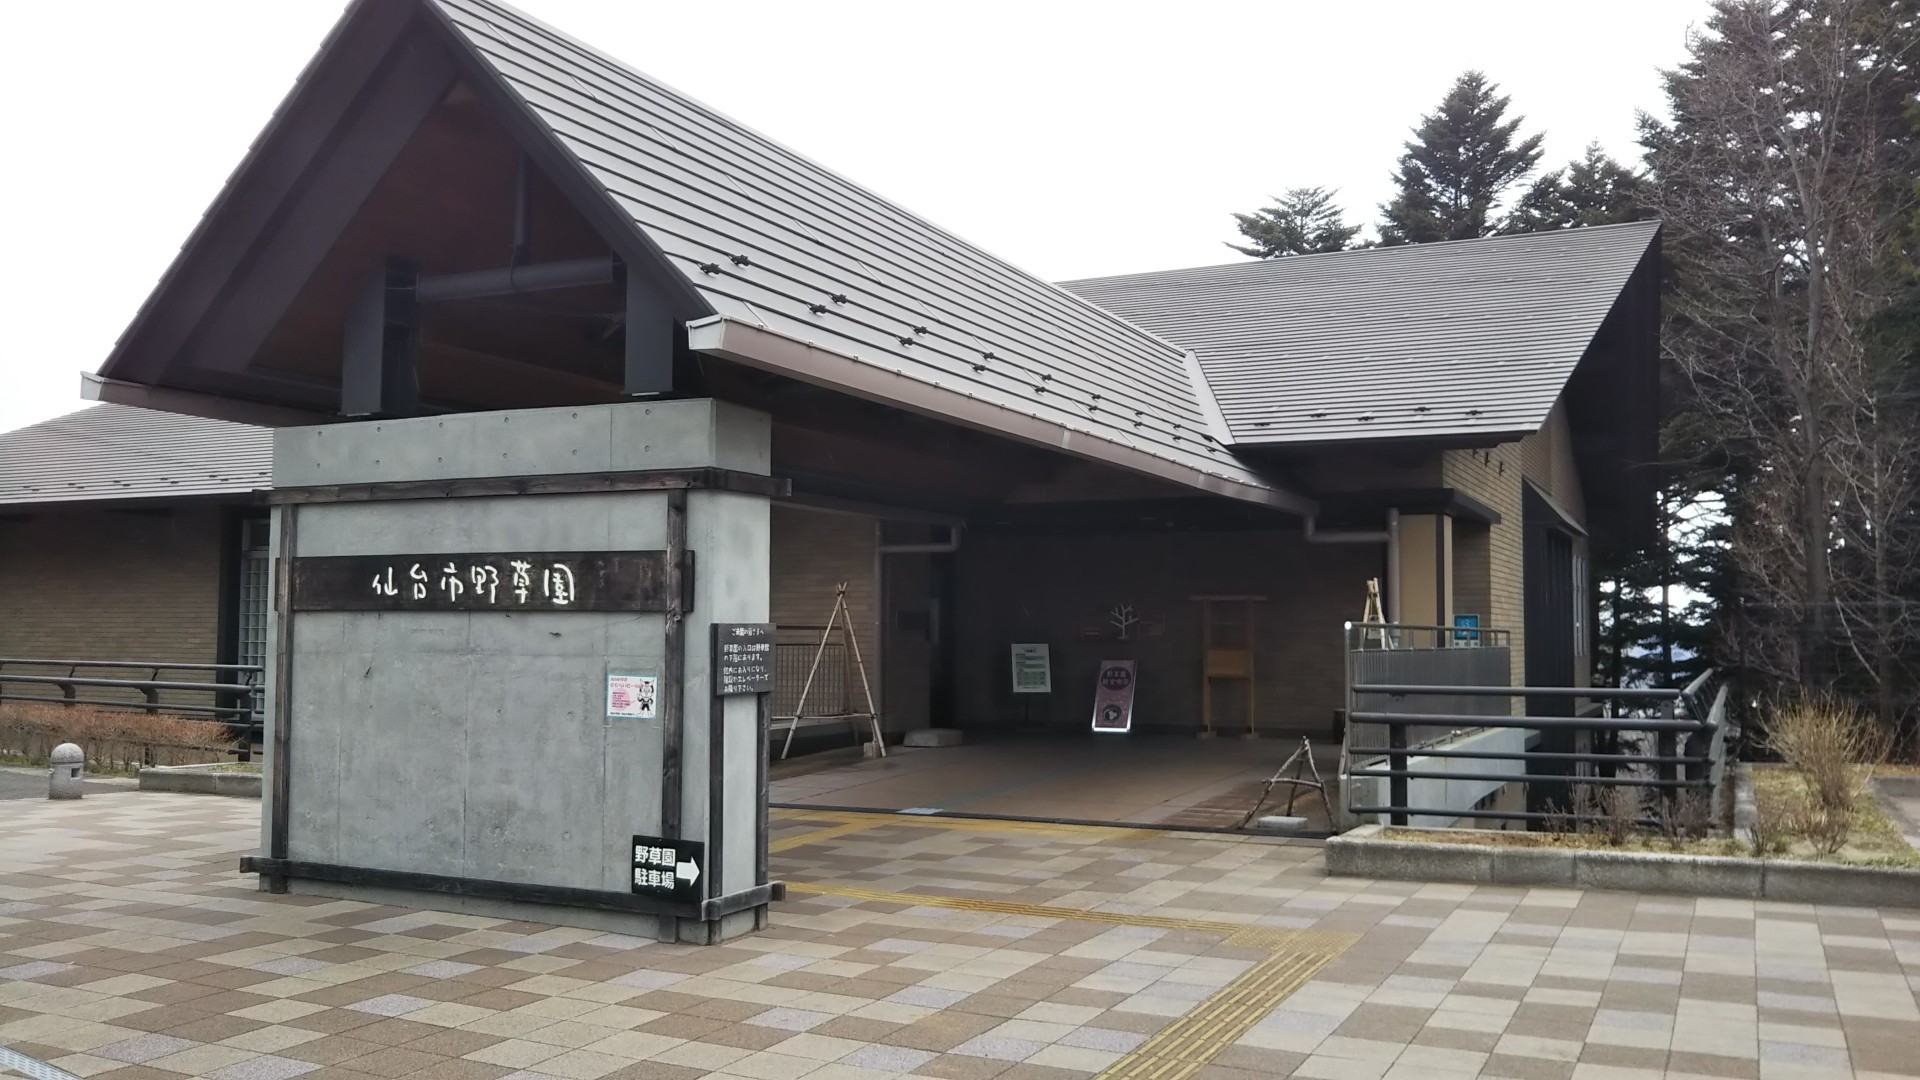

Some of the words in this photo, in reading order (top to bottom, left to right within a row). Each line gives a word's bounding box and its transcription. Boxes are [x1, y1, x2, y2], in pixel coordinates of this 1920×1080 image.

[372, 560, 574, 604] 仙台市野草園
[635, 845, 676, 867] 野草園
[634, 867, 675, 889] 駐車場
